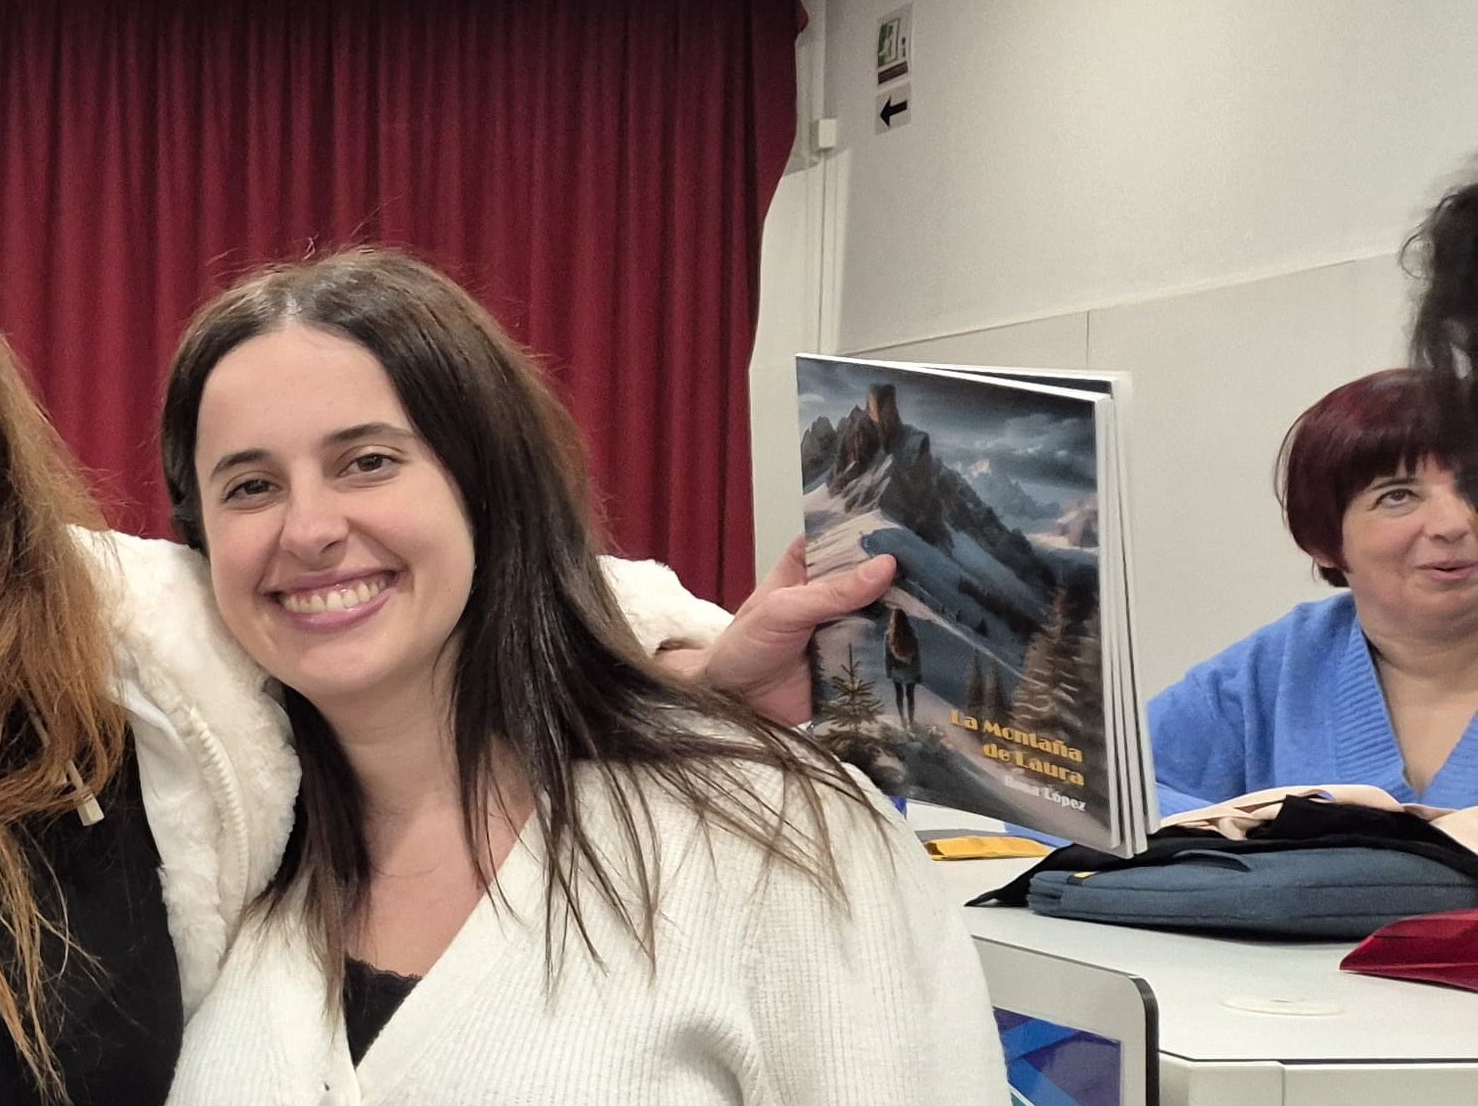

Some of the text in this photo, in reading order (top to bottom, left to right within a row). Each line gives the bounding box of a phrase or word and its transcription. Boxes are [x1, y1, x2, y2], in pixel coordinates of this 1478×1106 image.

[950, 710, 1082, 762] La Montaña
[983, 743, 1084, 786] de Laura
[1044, 785, 1087, 811] López
